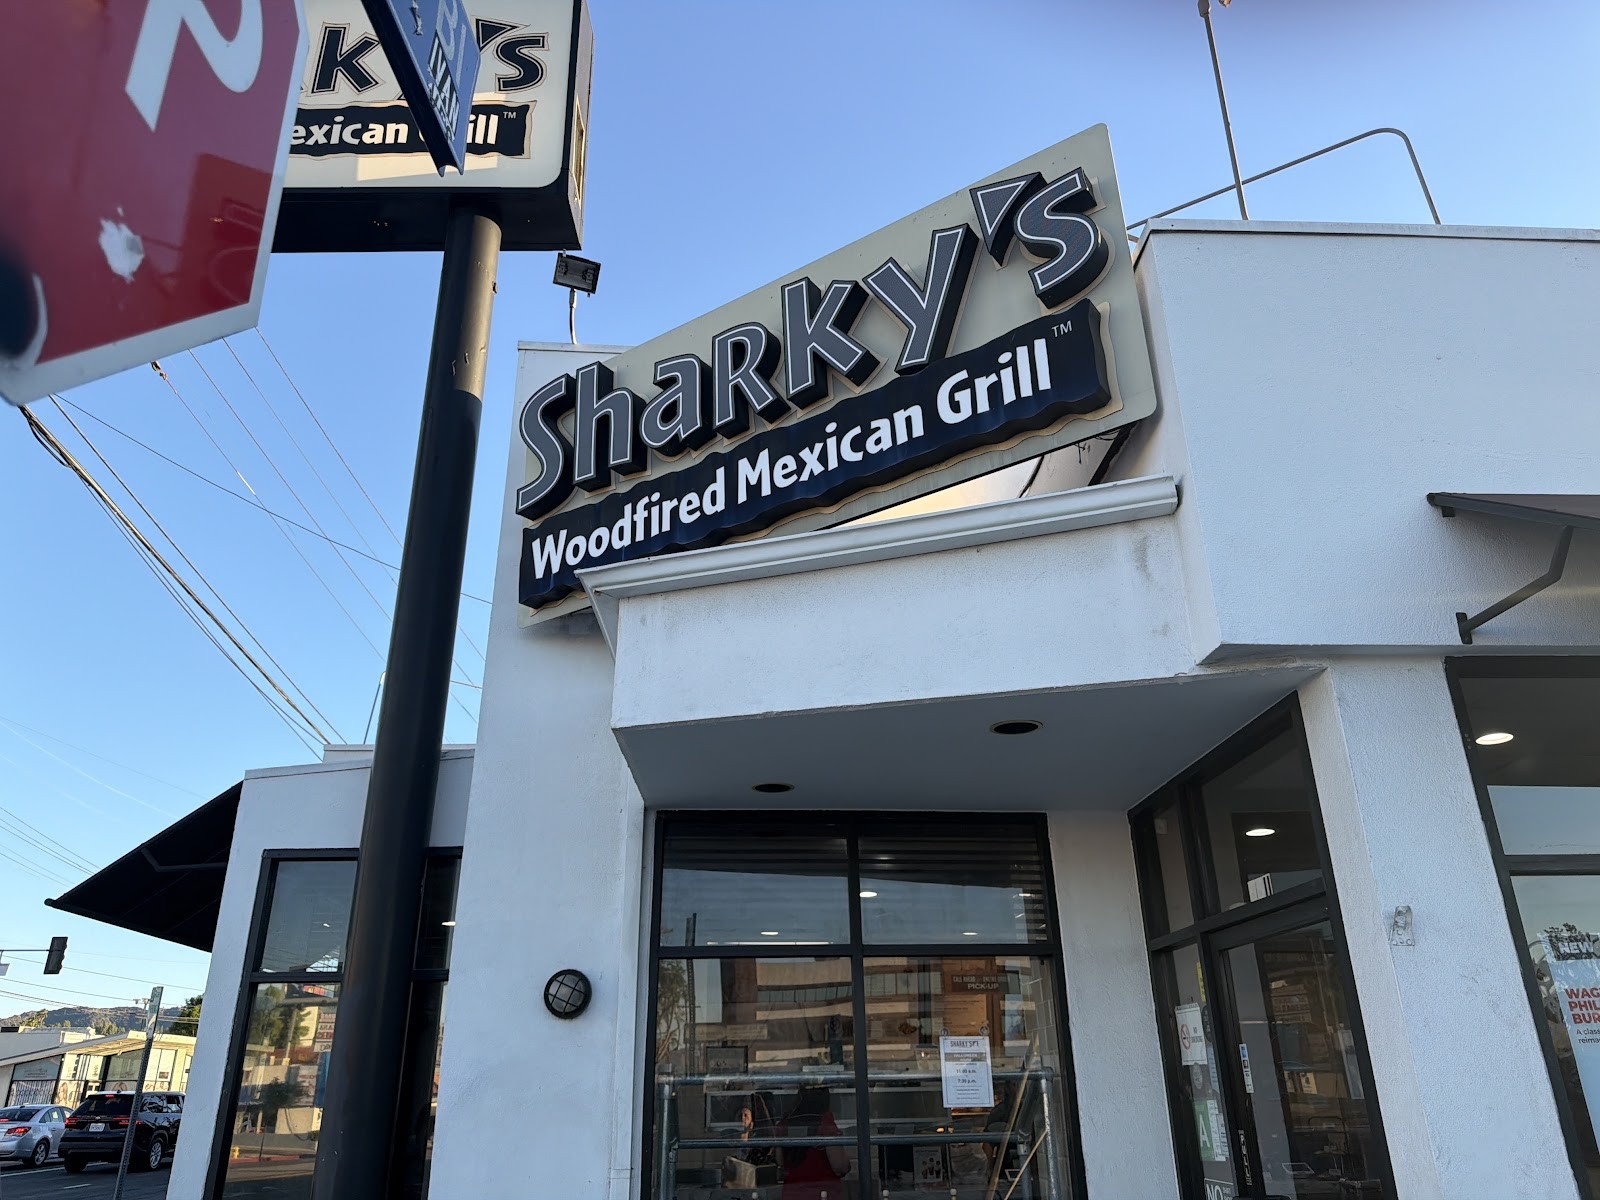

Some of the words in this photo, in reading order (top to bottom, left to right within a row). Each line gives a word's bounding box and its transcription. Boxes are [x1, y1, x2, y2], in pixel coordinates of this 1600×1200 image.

[427, 36, 459, 138] IVAN
[292, 115, 408, 145] exican
[532, 467, 725, 579] Woodfired
[736, 402, 925, 503] Mexican
[936, 338, 1051, 425] Grill
[1051, 320, 1073, 337] TM
[1558, 941, 1595, 954] NEW
[1565, 988, 1600, 999] WAG
[1199, 1114, 1211, 1148] A
